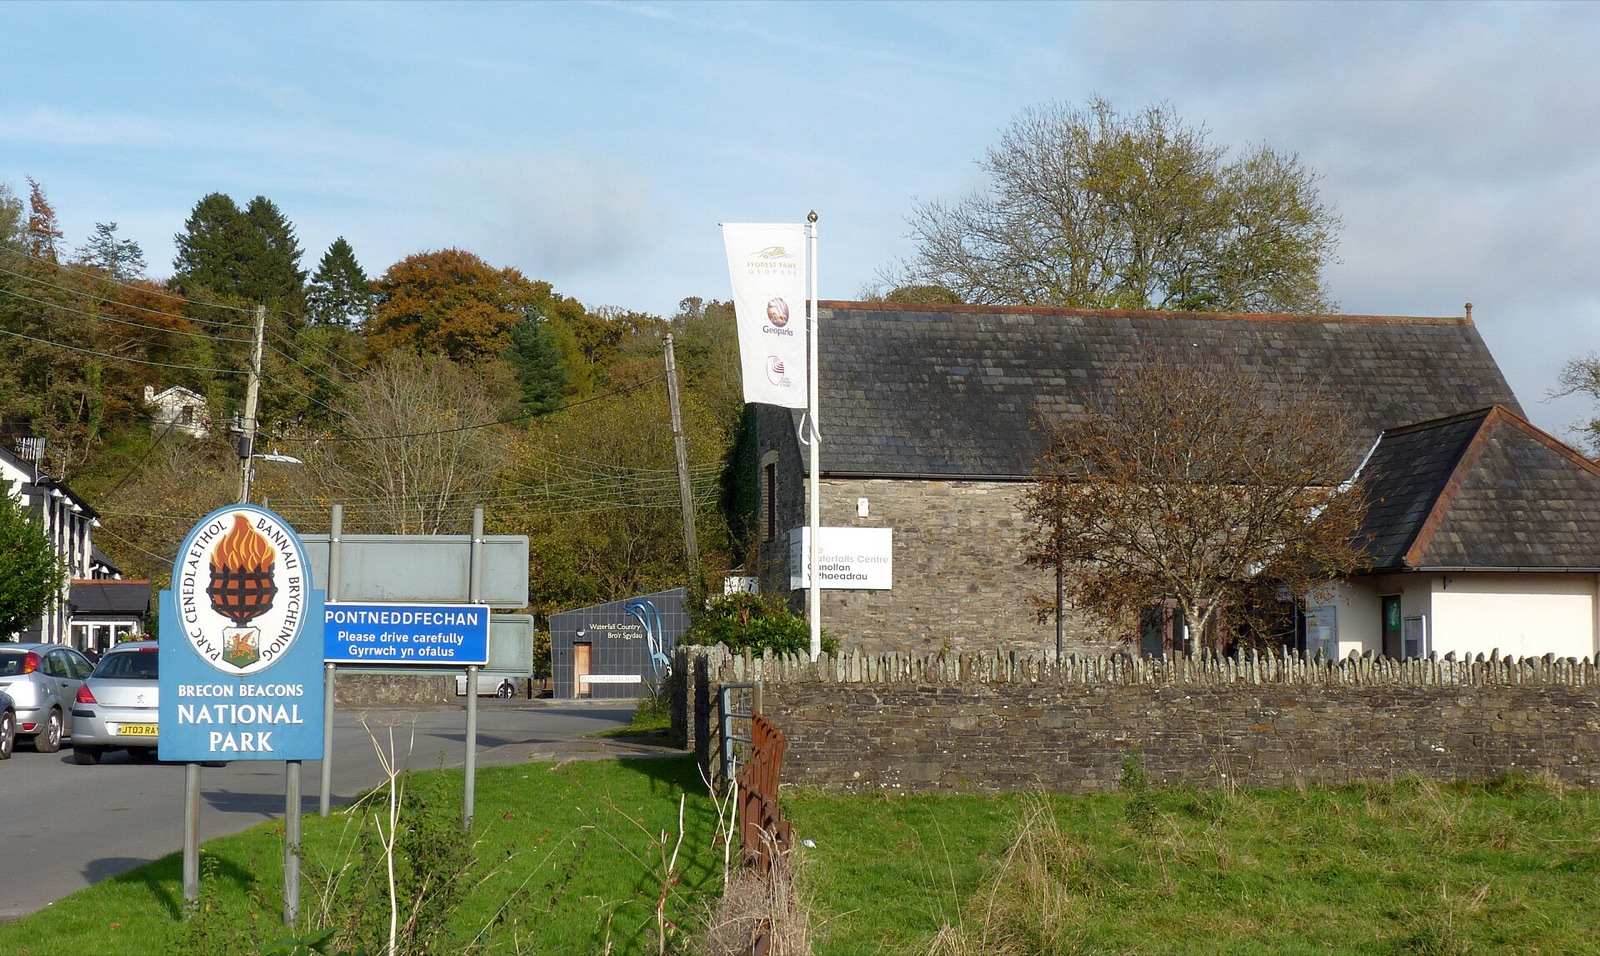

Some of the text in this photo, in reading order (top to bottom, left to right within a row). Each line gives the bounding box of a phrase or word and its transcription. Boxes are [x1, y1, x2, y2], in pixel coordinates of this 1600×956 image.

[762, 325, 794, 337] Geoparks
[857, 555, 889, 563] Centre
[182, 520, 228, 662] PARC CENEDLAETHOL
[256, 517, 301, 662] BANNAU BRYCHEINIOG
[324, 610, 478, 626] PONTNEDDFECHAN
[616, 623, 641, 631] Country
[338, 631, 464, 646] Please drive carefully
[622, 632, 643, 640] Sgydau
[349, 645, 455, 658] Gyrrwch yn ofalus
[178, 684, 304, 697] BRECON BEACONS
[178, 704, 304, 724] NATIONAL
[122, 726, 144, 734] JT03
[209, 731, 274, 752] PARK
